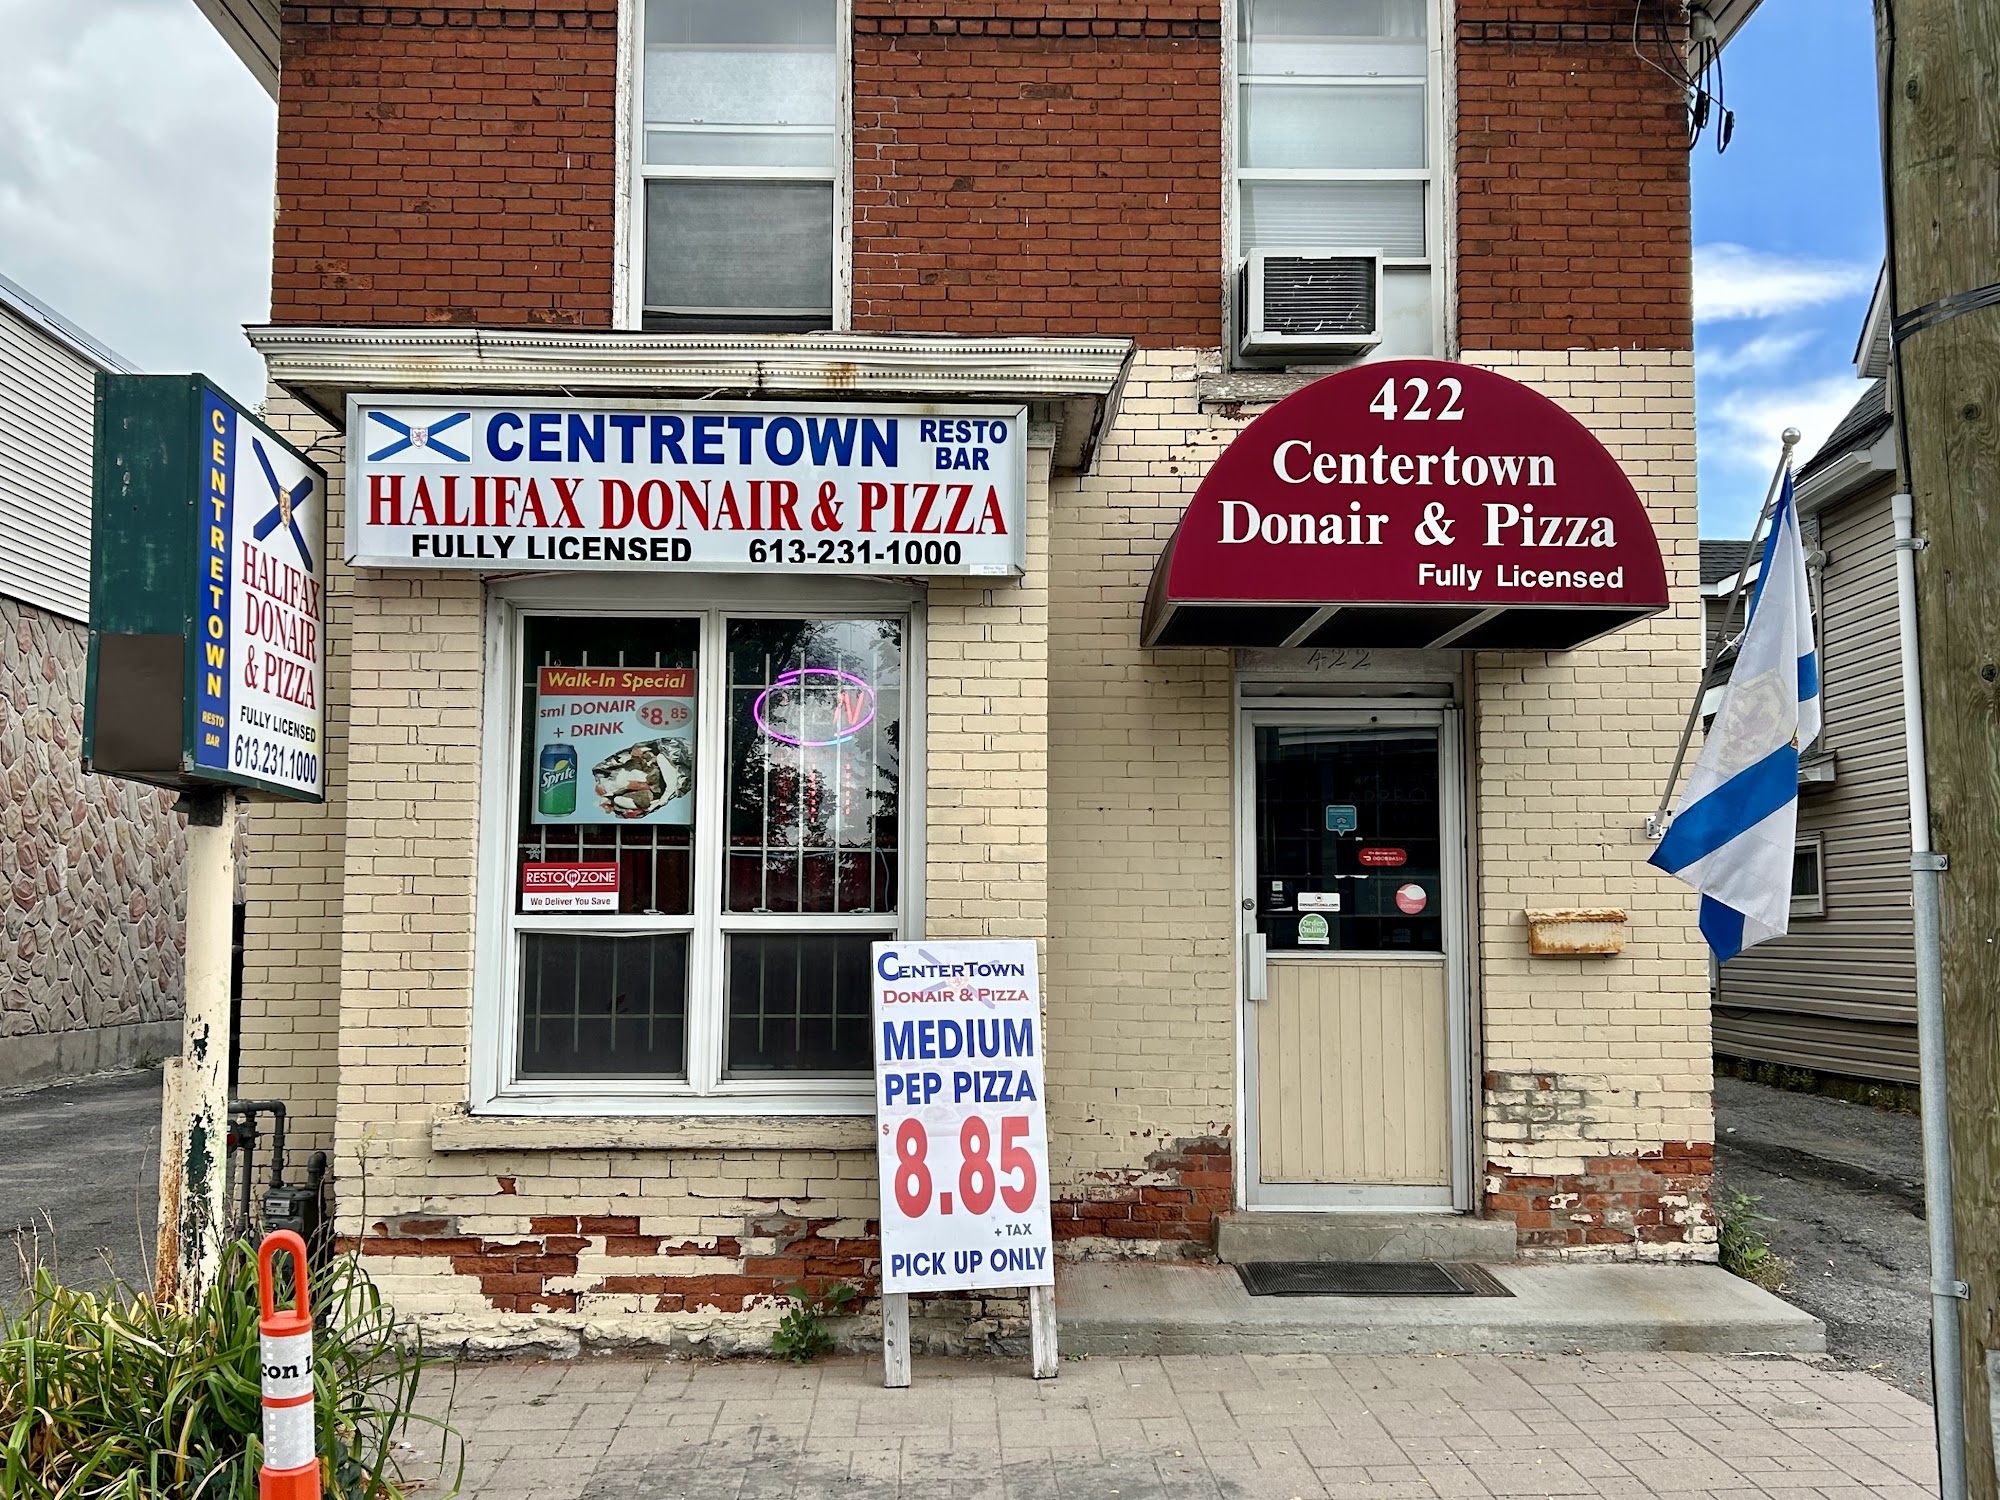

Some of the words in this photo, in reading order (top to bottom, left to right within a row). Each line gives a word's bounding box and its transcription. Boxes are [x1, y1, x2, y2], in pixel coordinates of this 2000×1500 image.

[1370, 377, 1465, 421] 422
[486, 411, 899, 468] CENTRETOWN
[919, 419, 1008, 444] RESTO
[935, 447, 991, 471] BAR
[1272, 438, 1557, 487] Centertown
[365, 474, 582, 529] HALIFAX
[599, 478, 804, 532] DONAIR
[810, 480, 844, 533] &
[857, 482, 1009, 535] PIZZA
[1217, 499, 1390, 546] Donair
[1414, 501, 1456, 547] &
[1482, 502, 1618, 549] Pizza
[205, 408, 227, 698] CENTRETOWN
[411, 533, 516, 560] FULLY
[528, 535, 693, 563] LICENSED
[748, 539, 962, 566] 613-231-1000
[242, 540, 321, 623] HALIFAX
[1418, 563, 1483, 592] Fully
[1497, 564, 1624, 589] Licensed
[244, 591, 317, 664] DONAIR
[1307, 648, 1371, 672] 422
[243, 645, 259, 689] &
[264, 650, 317, 711] PIZZA
[547, 671, 617, 689] Walk-In
[621, 673, 687, 692] Special
[202, 709, 225, 728] RESTO
[539, 702, 568, 719] sml
[570, 699, 636, 717] DONAIR
[640, 705, 689, 727] $8.85
[240, 704, 271, 732] FULLY
[272, 712, 317, 744] LICENSED
[570, 721, 625, 738] DRINK
[205, 732, 221, 748] BAR
[234, 733, 317, 785] 613.231.1000
[540, 765, 577, 788] Sprite
[530, 896, 542, 907] We
[544, 896, 573, 907] Deliver
[574, 896, 590, 907] You
[591, 896, 611, 907] Save
[1300, 925, 1327, 935] Online
[1302, 917, 1325, 927] Order
[882, 988, 955, 1005] DONAIR
[959, 988, 974, 1002] &
[977, 987, 1029, 1002] PIZZA
[882, 1018, 1035, 1062] MEDIUM
[884, 1072, 943, 1106] PEP
[953, 1069, 1037, 1104] PIZZA
[1005, 1223, 1032, 1237] TAX
[891, 1251, 946, 1278] PICK
[953, 1250, 983, 1275] UP
[989, 1246, 1047, 1272] ONLY
